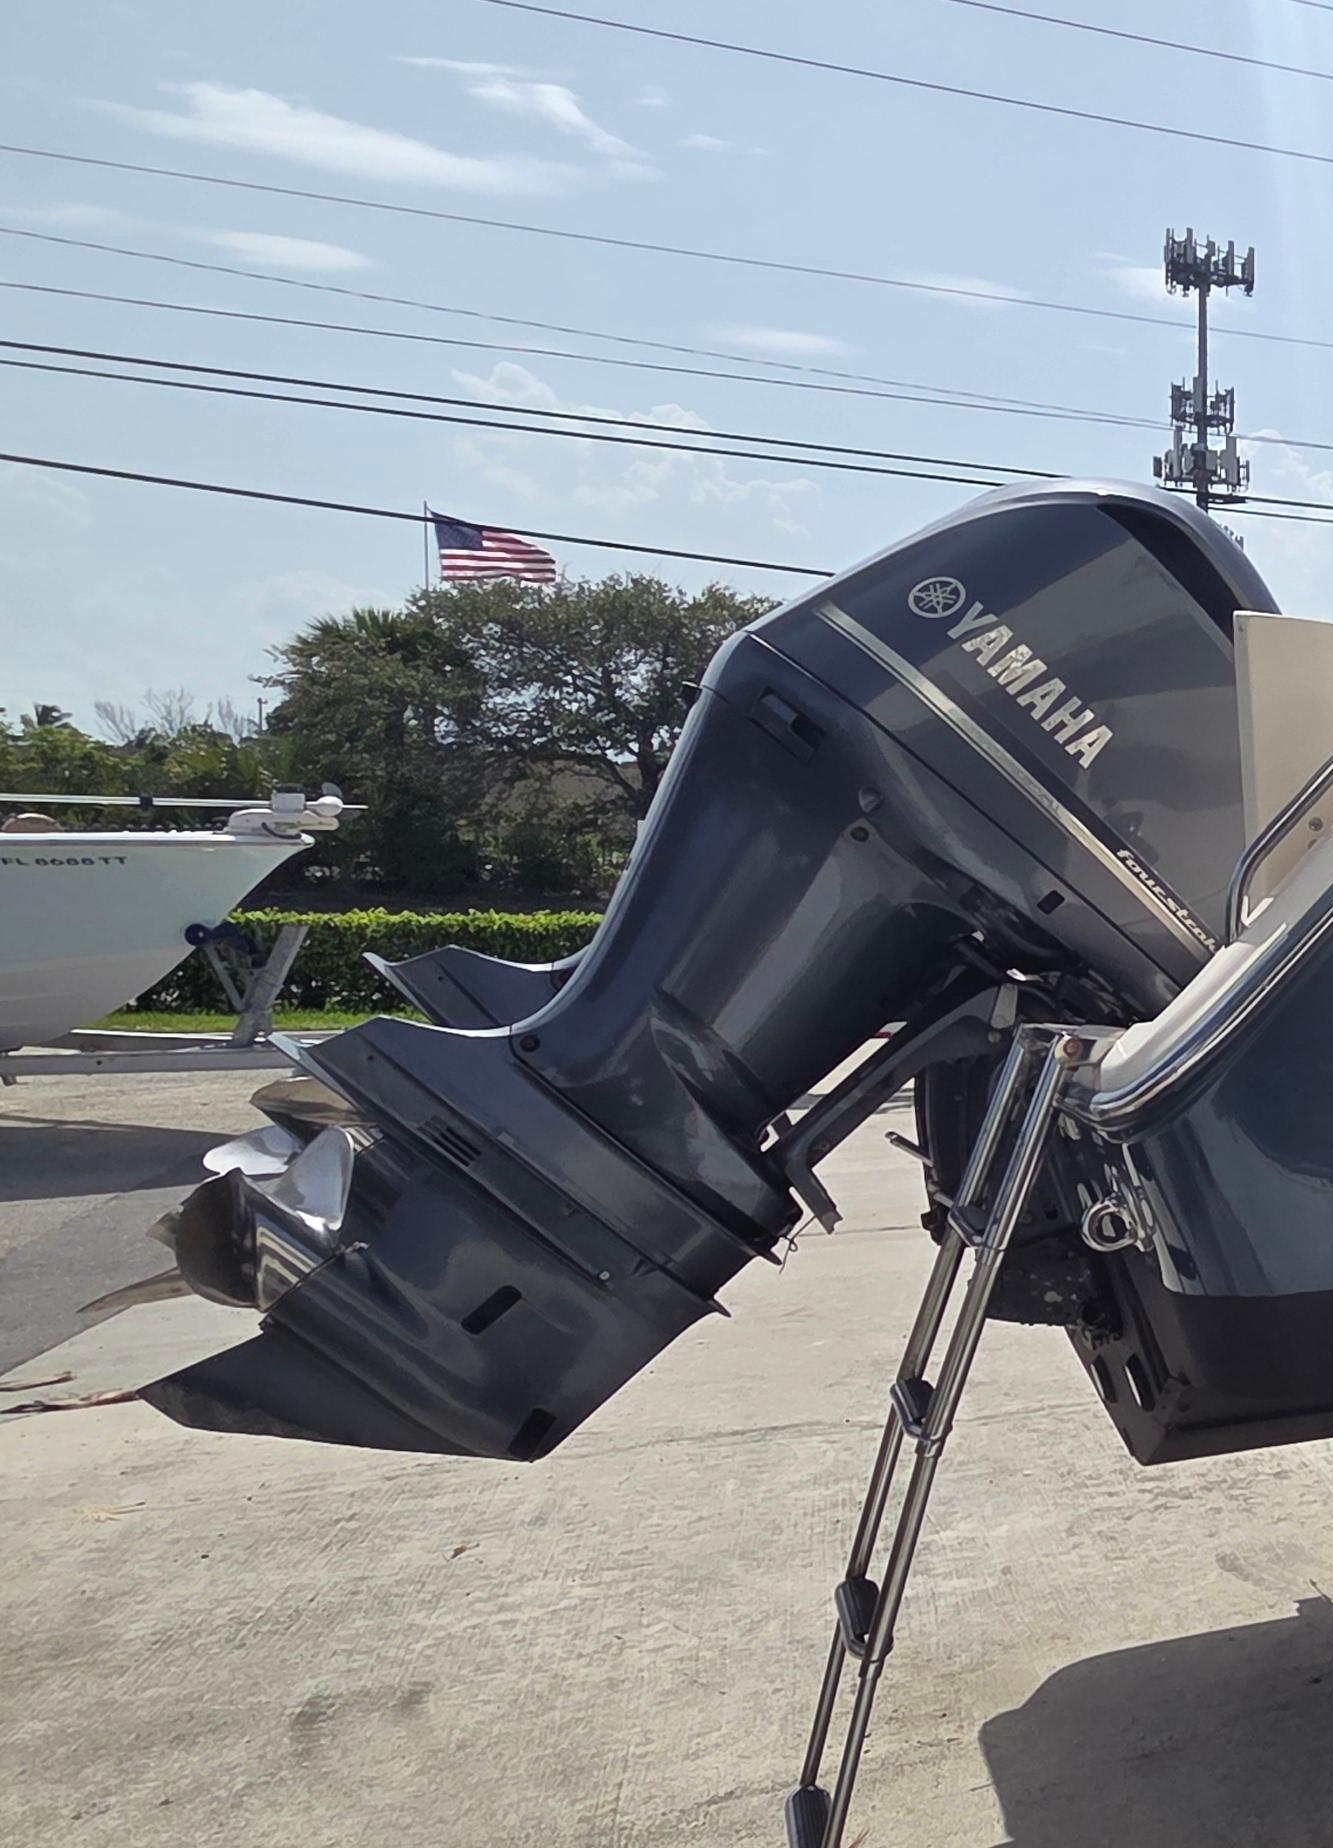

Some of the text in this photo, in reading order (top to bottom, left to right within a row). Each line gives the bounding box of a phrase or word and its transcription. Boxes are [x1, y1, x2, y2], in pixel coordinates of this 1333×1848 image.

[947, 602, 1114, 769] YAMAHA
[1, 857, 30, 866] FL
[98, 856, 128, 865] TT
